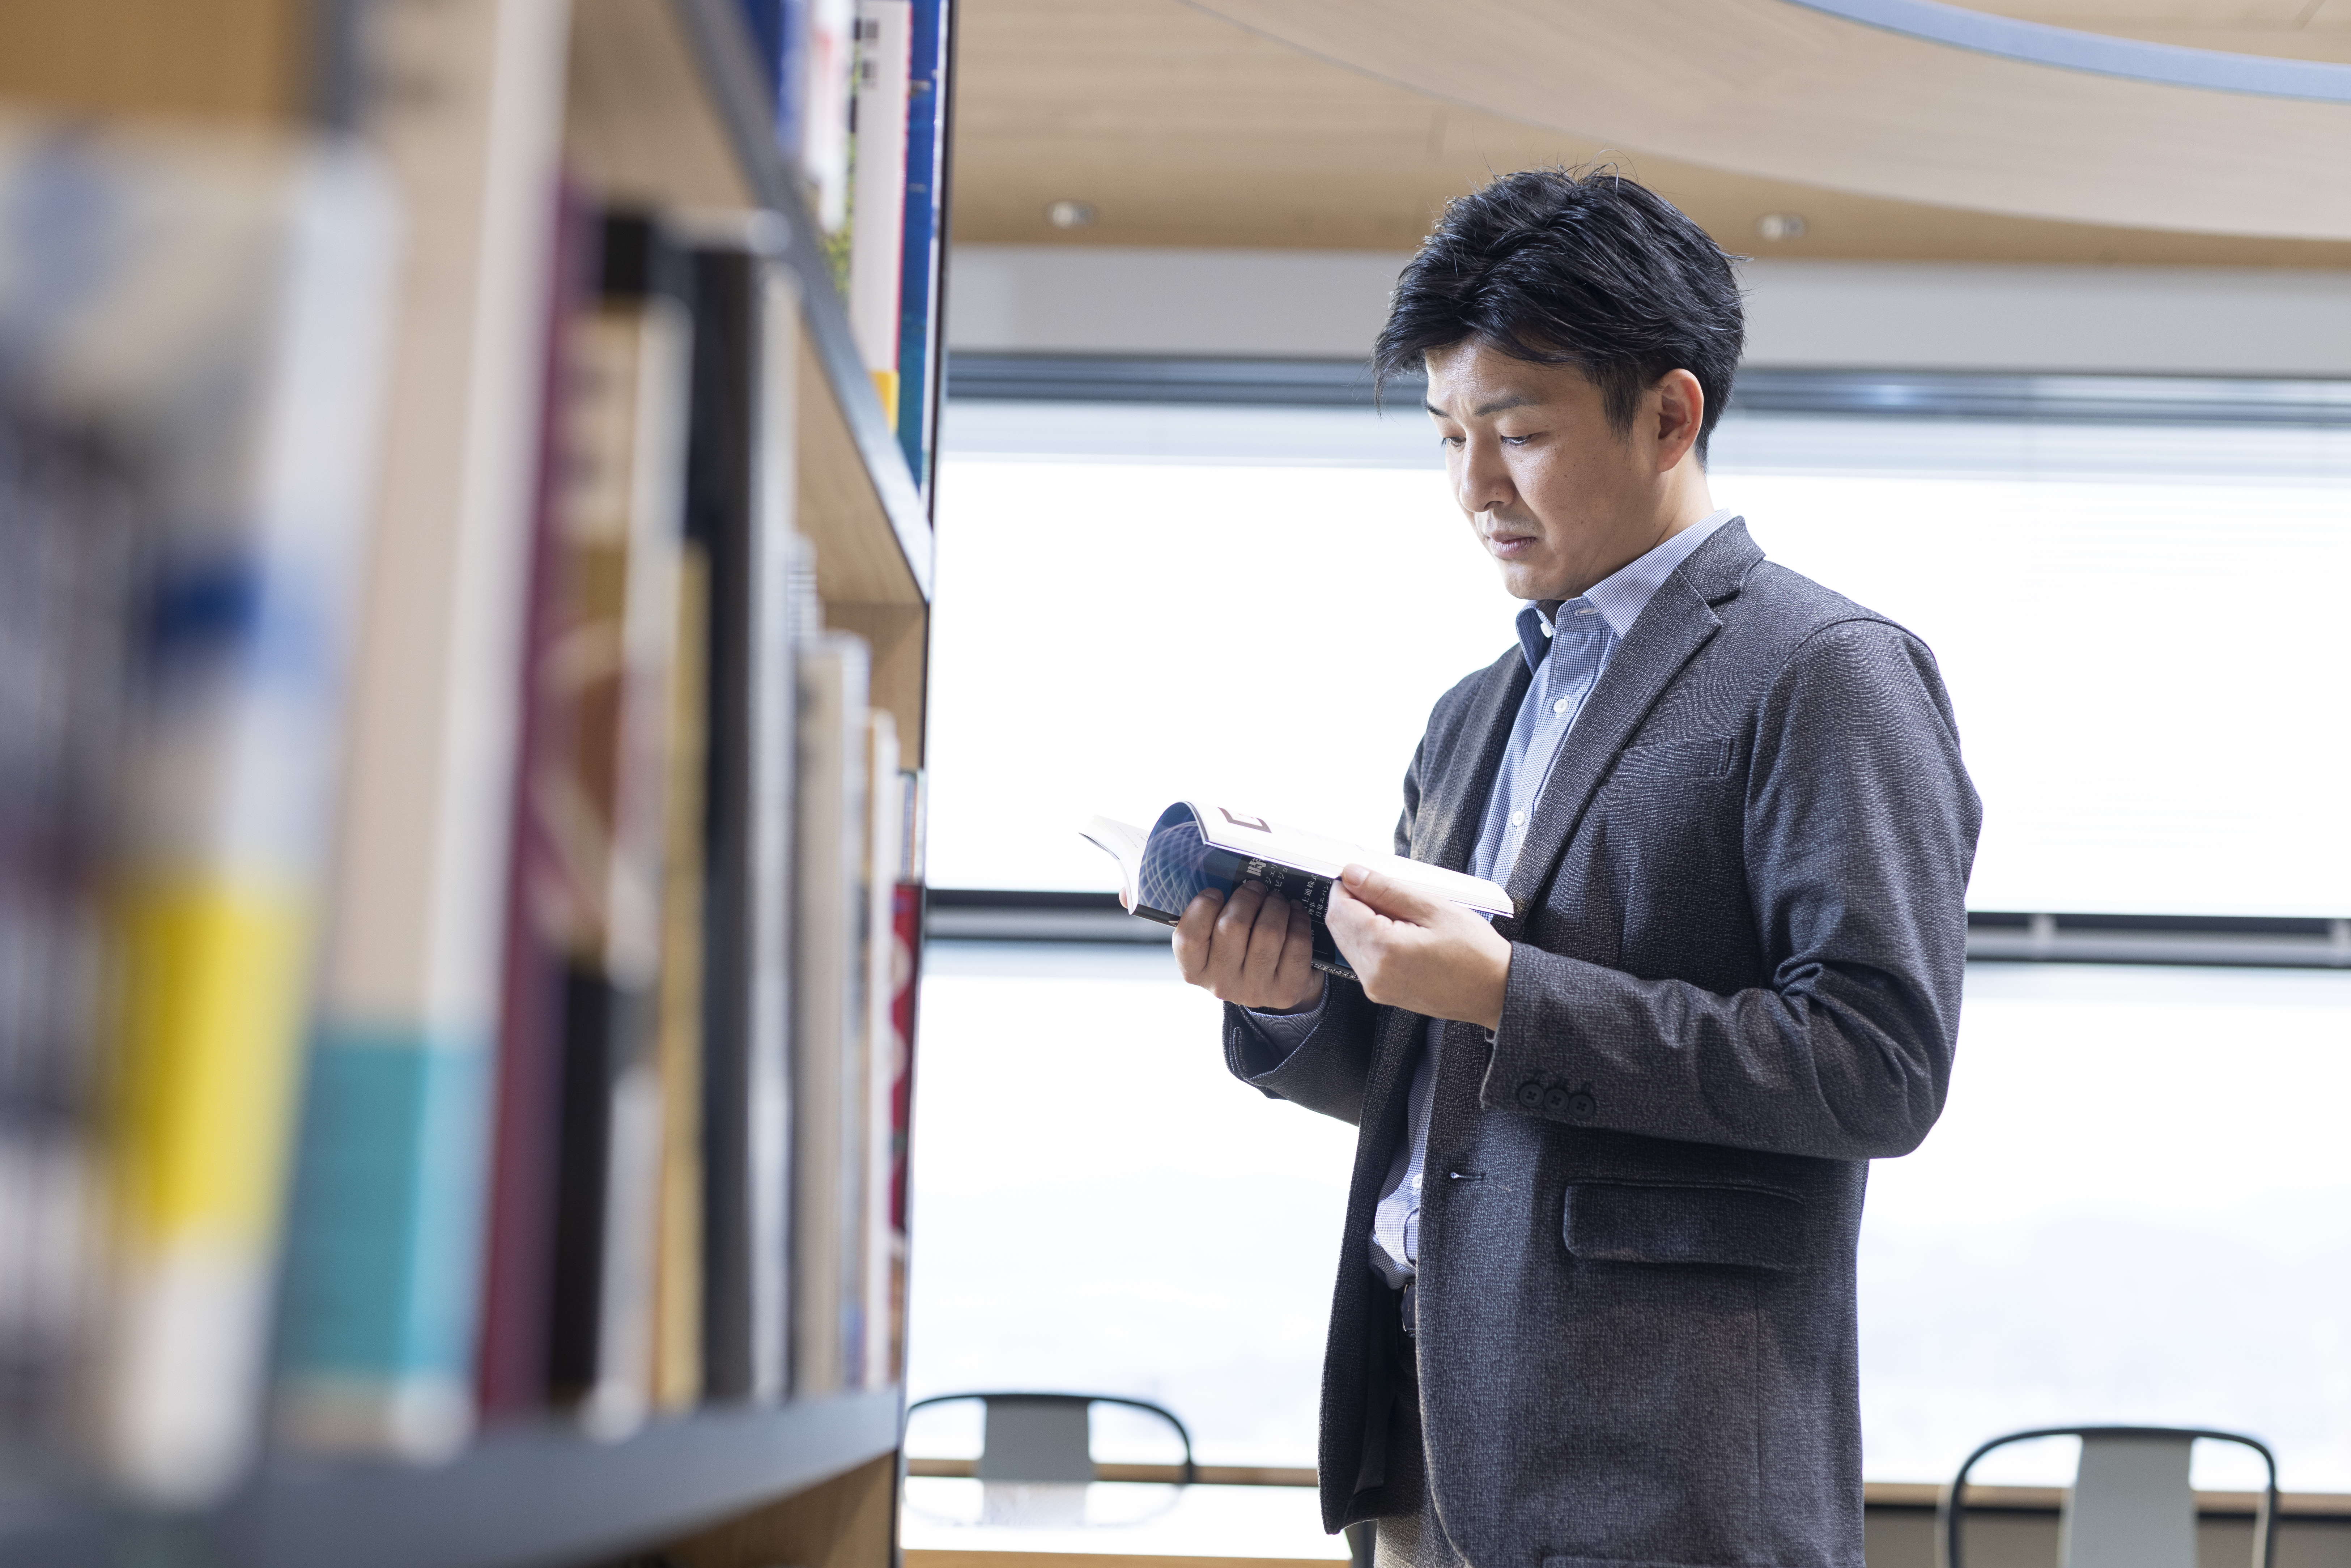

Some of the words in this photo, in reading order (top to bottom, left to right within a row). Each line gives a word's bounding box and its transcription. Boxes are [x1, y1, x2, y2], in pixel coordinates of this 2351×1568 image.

[1242, 858, 1266, 884] 時
[1302, 874, 1319, 909] 士通株式
[1315, 879, 1331, 917] 首席エバンジ
[1308, 901, 1315, 915] 理事
[1311, 961, 1360, 981] 見据える未来
